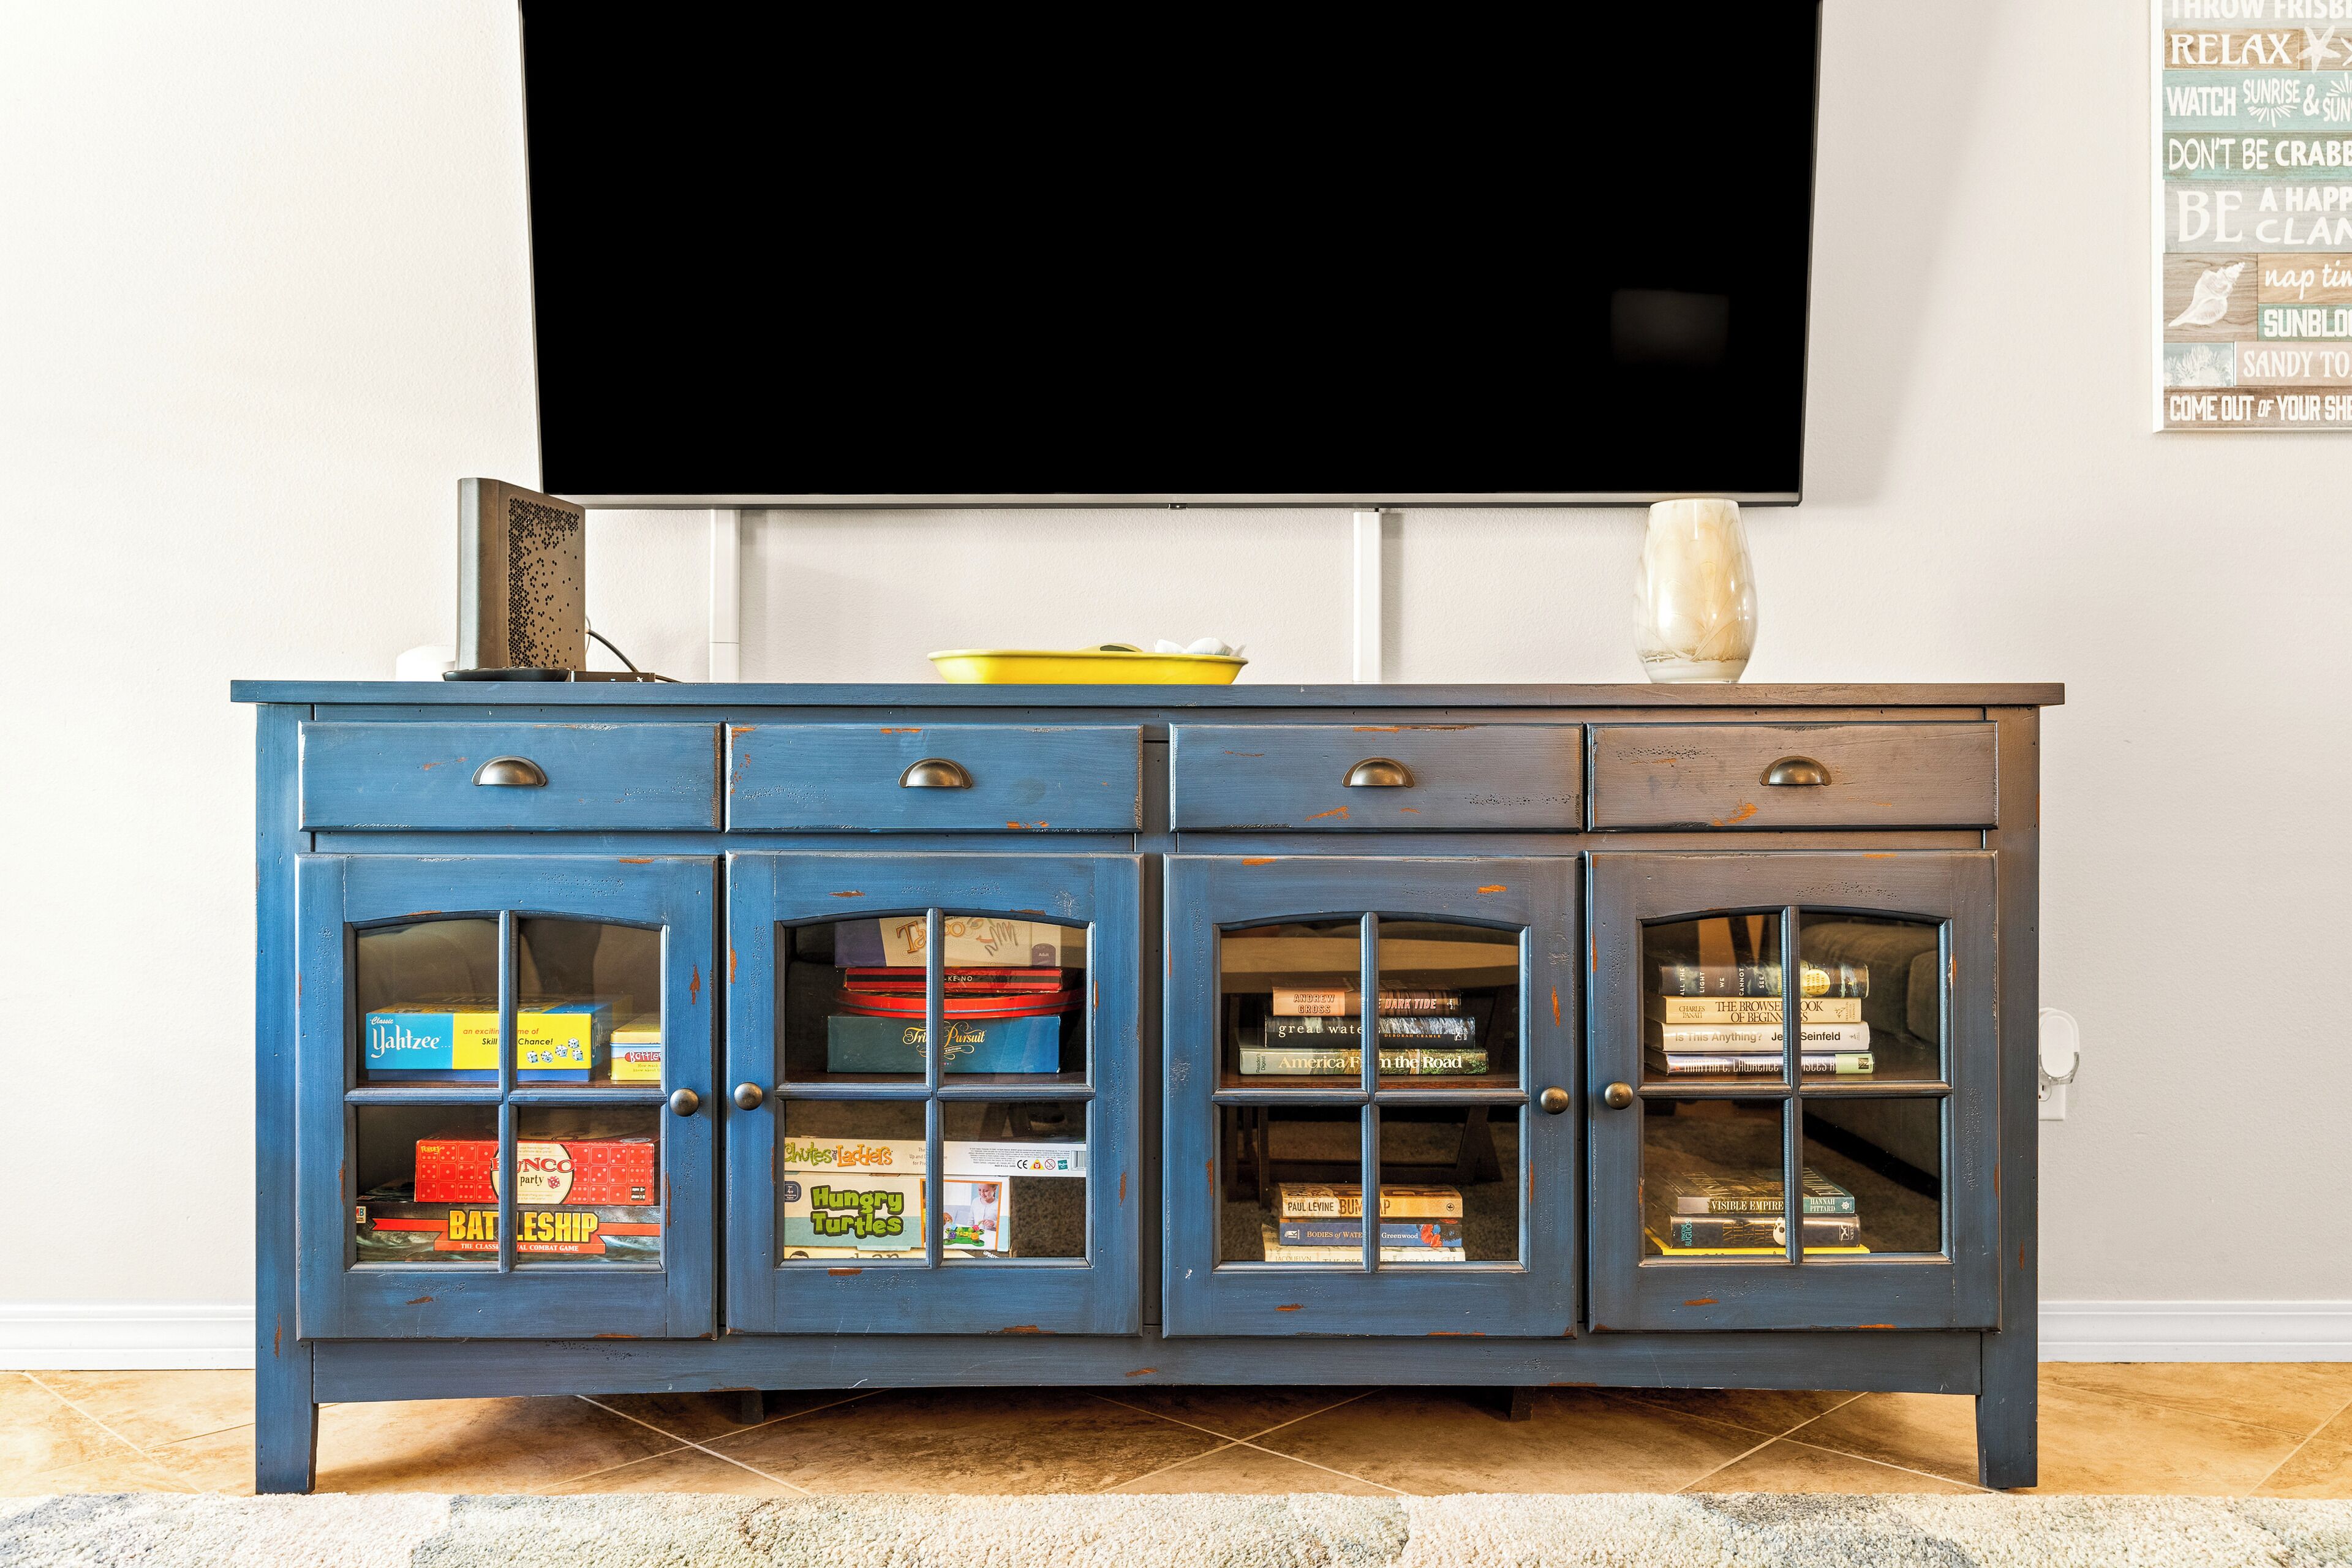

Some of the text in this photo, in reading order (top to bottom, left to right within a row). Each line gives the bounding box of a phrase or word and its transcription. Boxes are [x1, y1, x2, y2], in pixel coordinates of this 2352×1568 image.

[2171, 33, 2293, 65] RELAX
[2166, 78, 2352, 122] WATCH SUNRISE & SUN
[2169, 137, 2236, 171] DON'T
[2242, 138, 2269, 170] BE
[2259, 186, 2352, 211] A HAPP
[2176, 190, 2244, 243] BE
[2265, 268, 2315, 300] nap
[2243, 350, 2352, 378] SANDY TO
[2169, 394, 2218, 421] COME
[2222, 394, 2255, 421] OUT
[2276, 394, 2321, 421] YOUR
[895, 918, 965, 954] Tao
[1719, 977, 1725, 988] WE
[1293, 993, 1335, 1003] ANDREW
[1384, 998, 1411, 1009] DARK
[1414, 998, 1437, 1009] TIDE
[1298, 1005, 1331, 1014] GROSS
[1715, 1000, 1823, 1012] THE BROWSE OOK
[371, 1016, 394, 1025] Classic
[1730, 1012, 1745, 1022] OF
[944, 1021, 986, 1048] Pursuit
[1278, 1023, 1380, 1038] great wate
[1675, 1033, 1684, 1041] Is
[1687, 1032, 1709, 1041] This
[1711, 1032, 1762, 1043] Anything?
[1801, 1031, 1841, 1041] Seinfeld
[1279, 1055, 1346, 1069] America
[1395, 1055, 1420, 1069] the
[1422, 1055, 1463, 1069] Road
[1684, 1058, 1779, 1072] MARTHA C. LAWRENCE
[1801, 1058, 1827, 1072] ISCES
[785, 1141, 832, 1166] Chutes
[836, 1144, 893, 1167] Ladders
[520, 1175, 545, 1186] party
[811, 1185, 904, 1215] Hungry
[1287, 1202, 1334, 1212] PAUL LEVINE
[1340, 1199, 1363, 1215] BUM
[1711, 1200, 1784, 1210] VISIBLE EMPIRE
[450, 1210, 598, 1242] BATESHIP
[811, 1212, 903, 1239] Turtles
